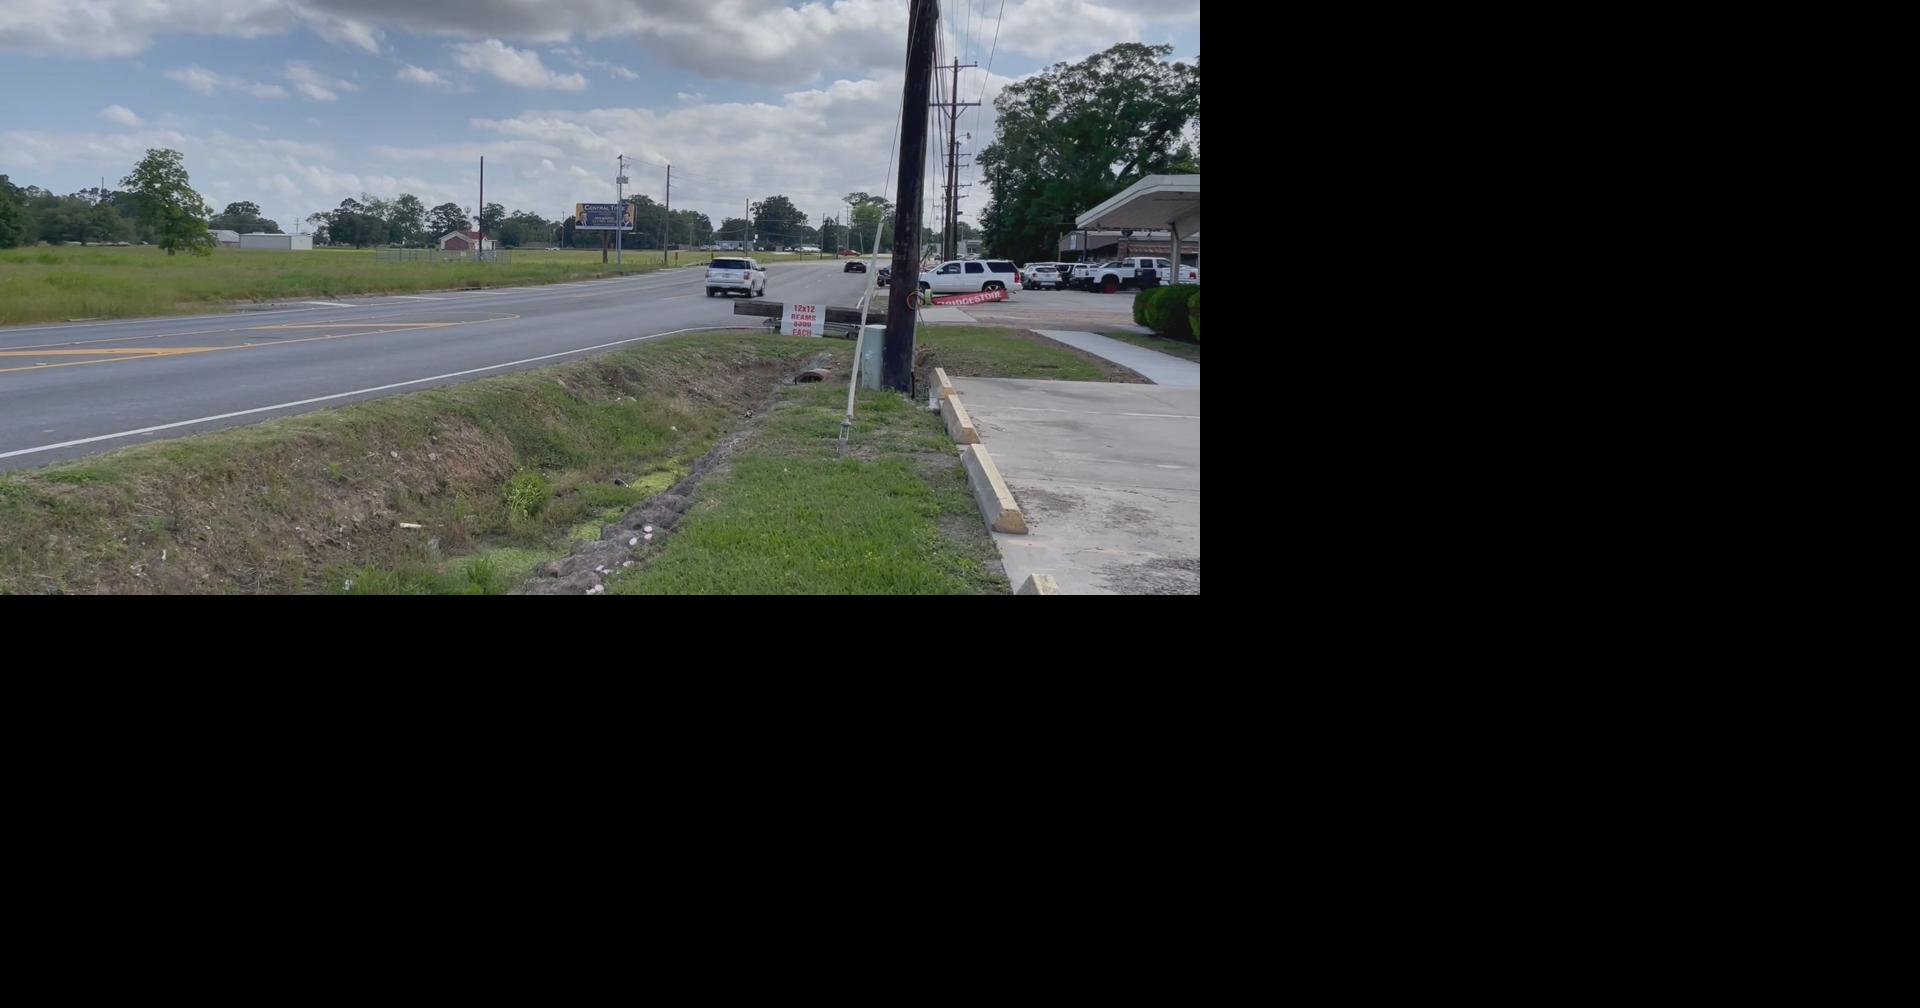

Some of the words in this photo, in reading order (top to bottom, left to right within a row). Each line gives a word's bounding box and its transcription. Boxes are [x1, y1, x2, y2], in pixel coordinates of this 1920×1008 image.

[936, 291, 1001, 305] RIDGESTONE
[794, 304, 816, 313] 12x12
[792, 329, 812, 337] EACH
